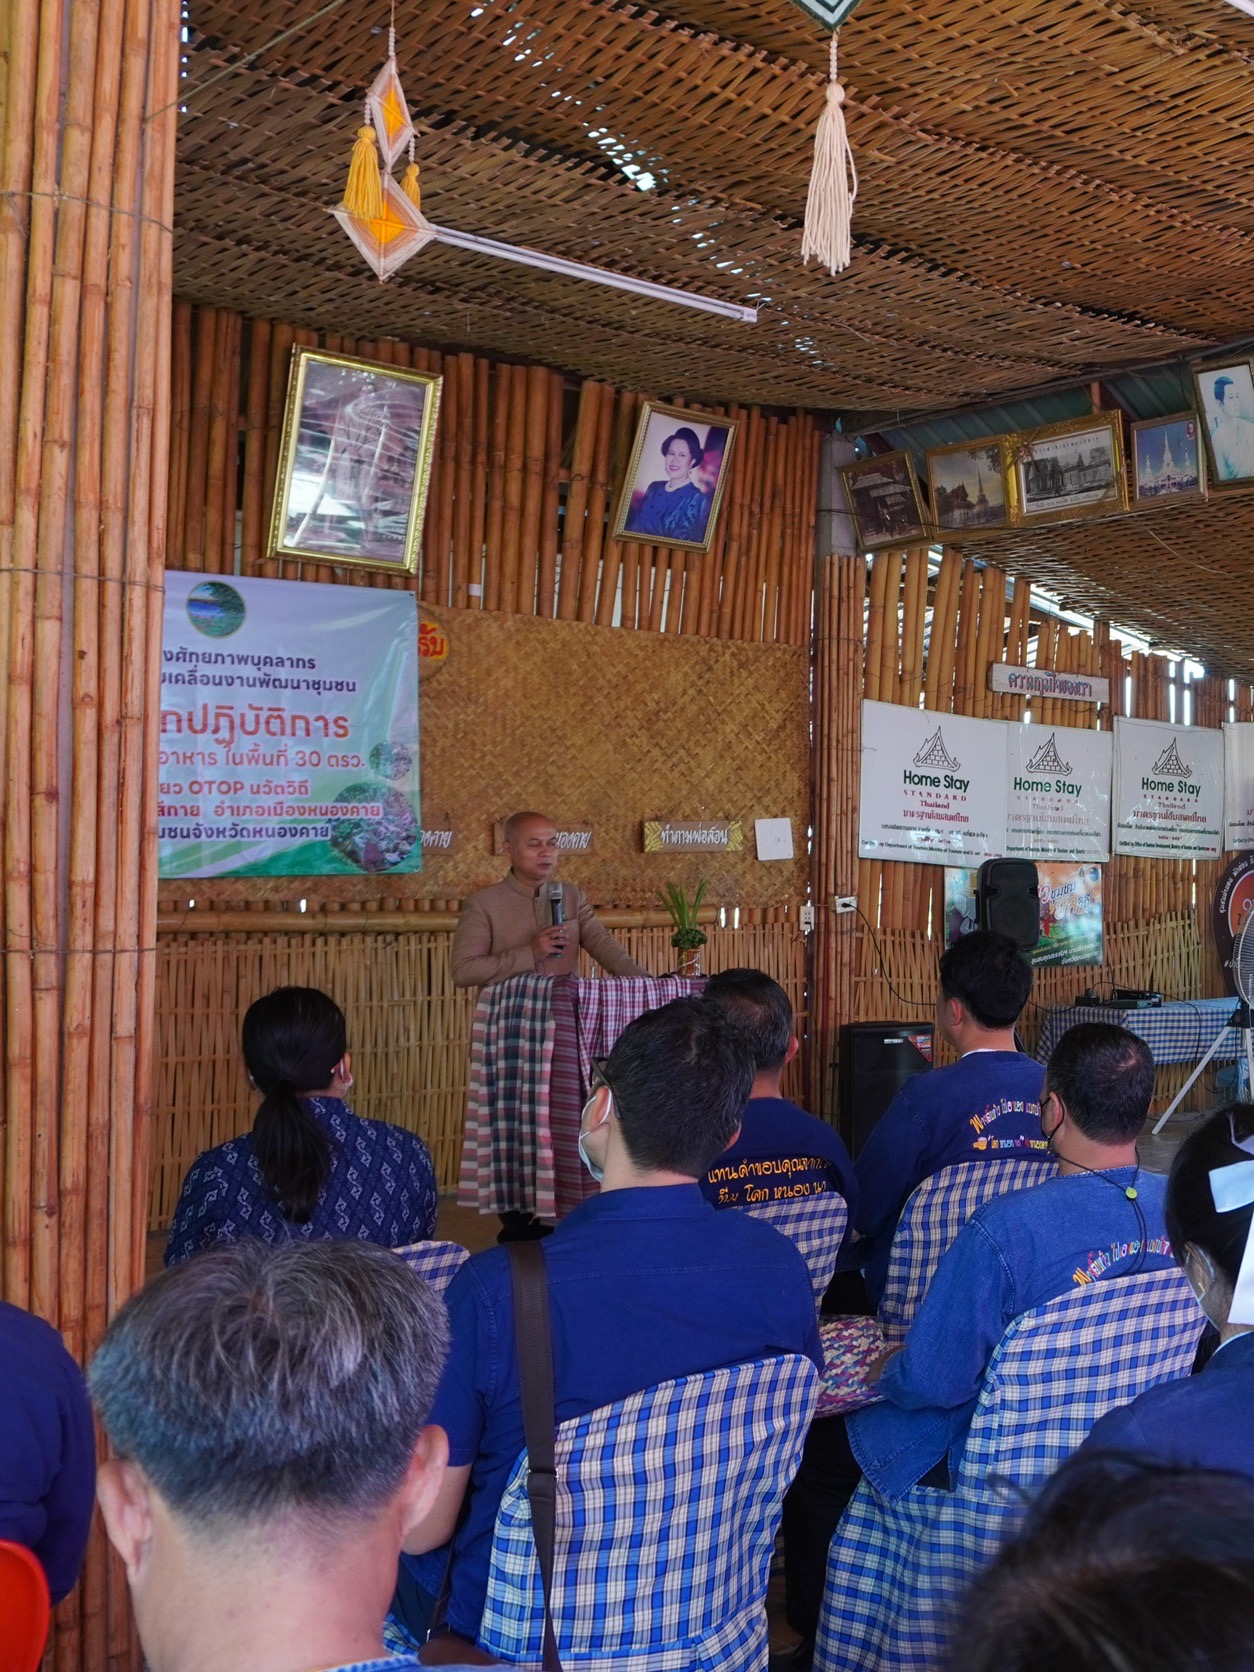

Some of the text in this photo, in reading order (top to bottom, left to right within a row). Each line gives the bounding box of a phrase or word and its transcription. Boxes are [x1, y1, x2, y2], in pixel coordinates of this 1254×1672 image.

[225, 741, 288, 768] ในพื้นที่
[295, 752, 321, 768] 30
[328, 754, 365, 768] ตรว.
[189, 781, 245, 796] OTOP
[250, 778, 310, 796] นวัตวิถี
[903, 770, 970, 793] Home Stay
[1014, 777, 1082, 797] Home Stay
[1141, 777, 1201, 798] Home Stay
[903, 789, 967, 801] STANDARD
[920, 800, 950, 809] Thailand
[214, 800, 381, 818] อำเภอเมืองหนองคาย
[661, 822, 728, 846] ทำตามพ่อสอน
[744, 1184, 769, 1202] โคก
[774, 1183, 811, 1199] หนอง
